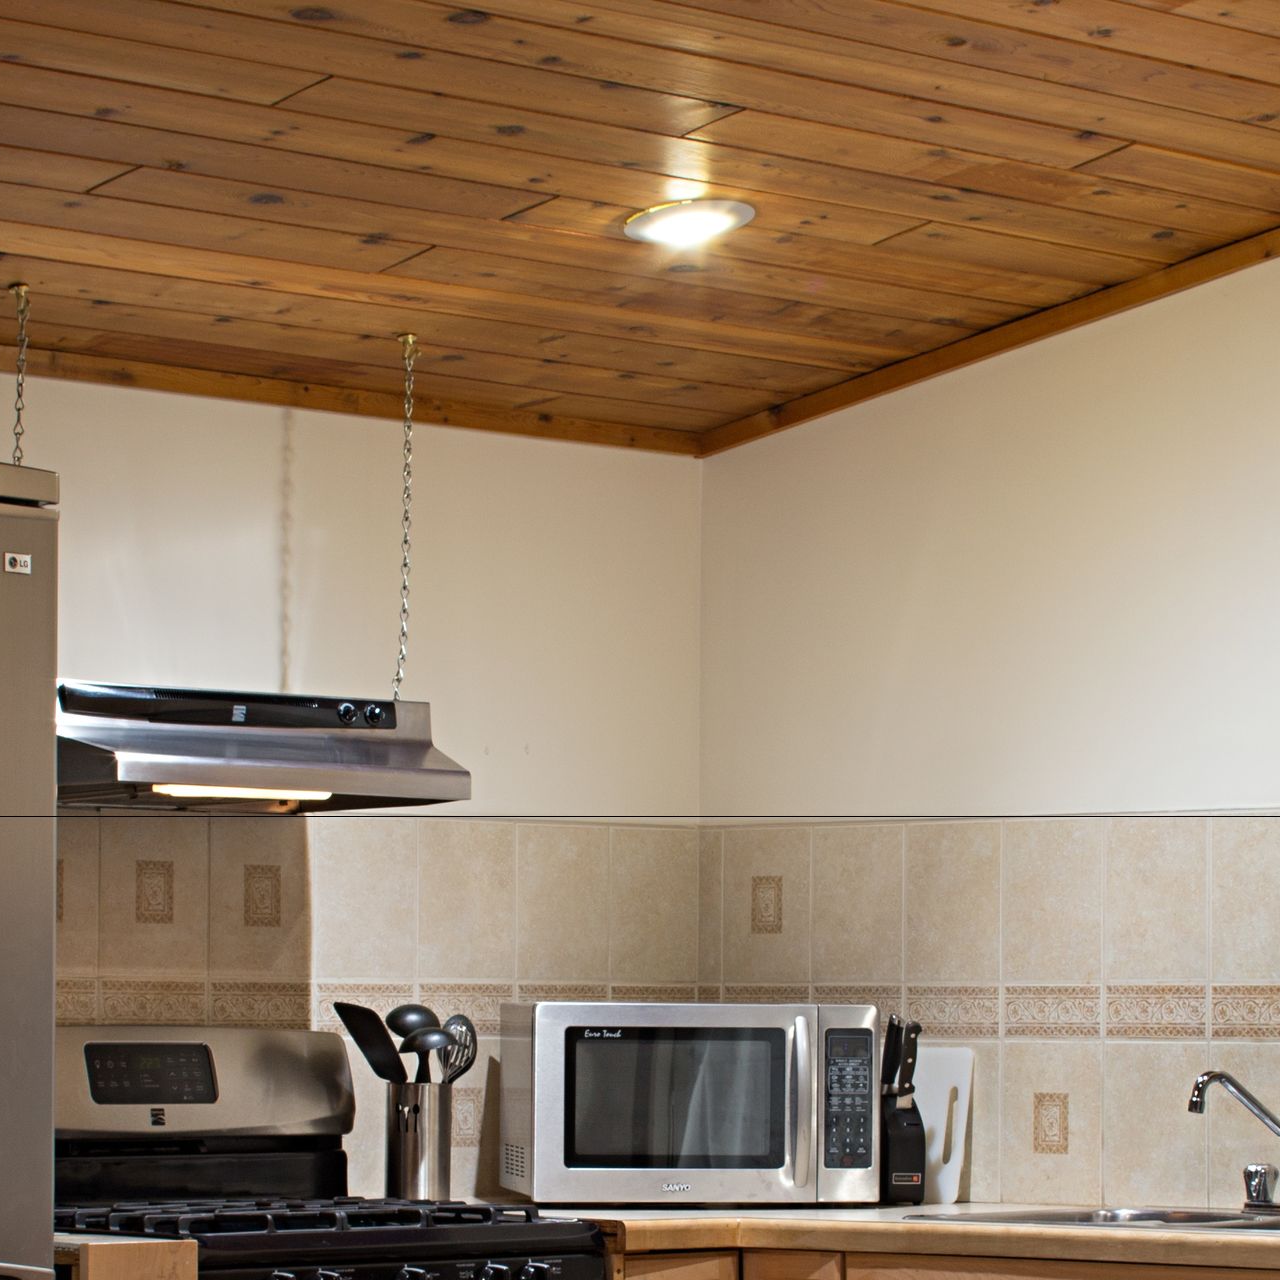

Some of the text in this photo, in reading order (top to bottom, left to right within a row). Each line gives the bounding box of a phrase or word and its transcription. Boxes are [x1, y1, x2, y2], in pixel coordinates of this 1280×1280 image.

[19, 560, 29, 568] LG
[584, 1029, 622, 1038] Euro Touch
[662, 1183, 691, 1192] SANYO
